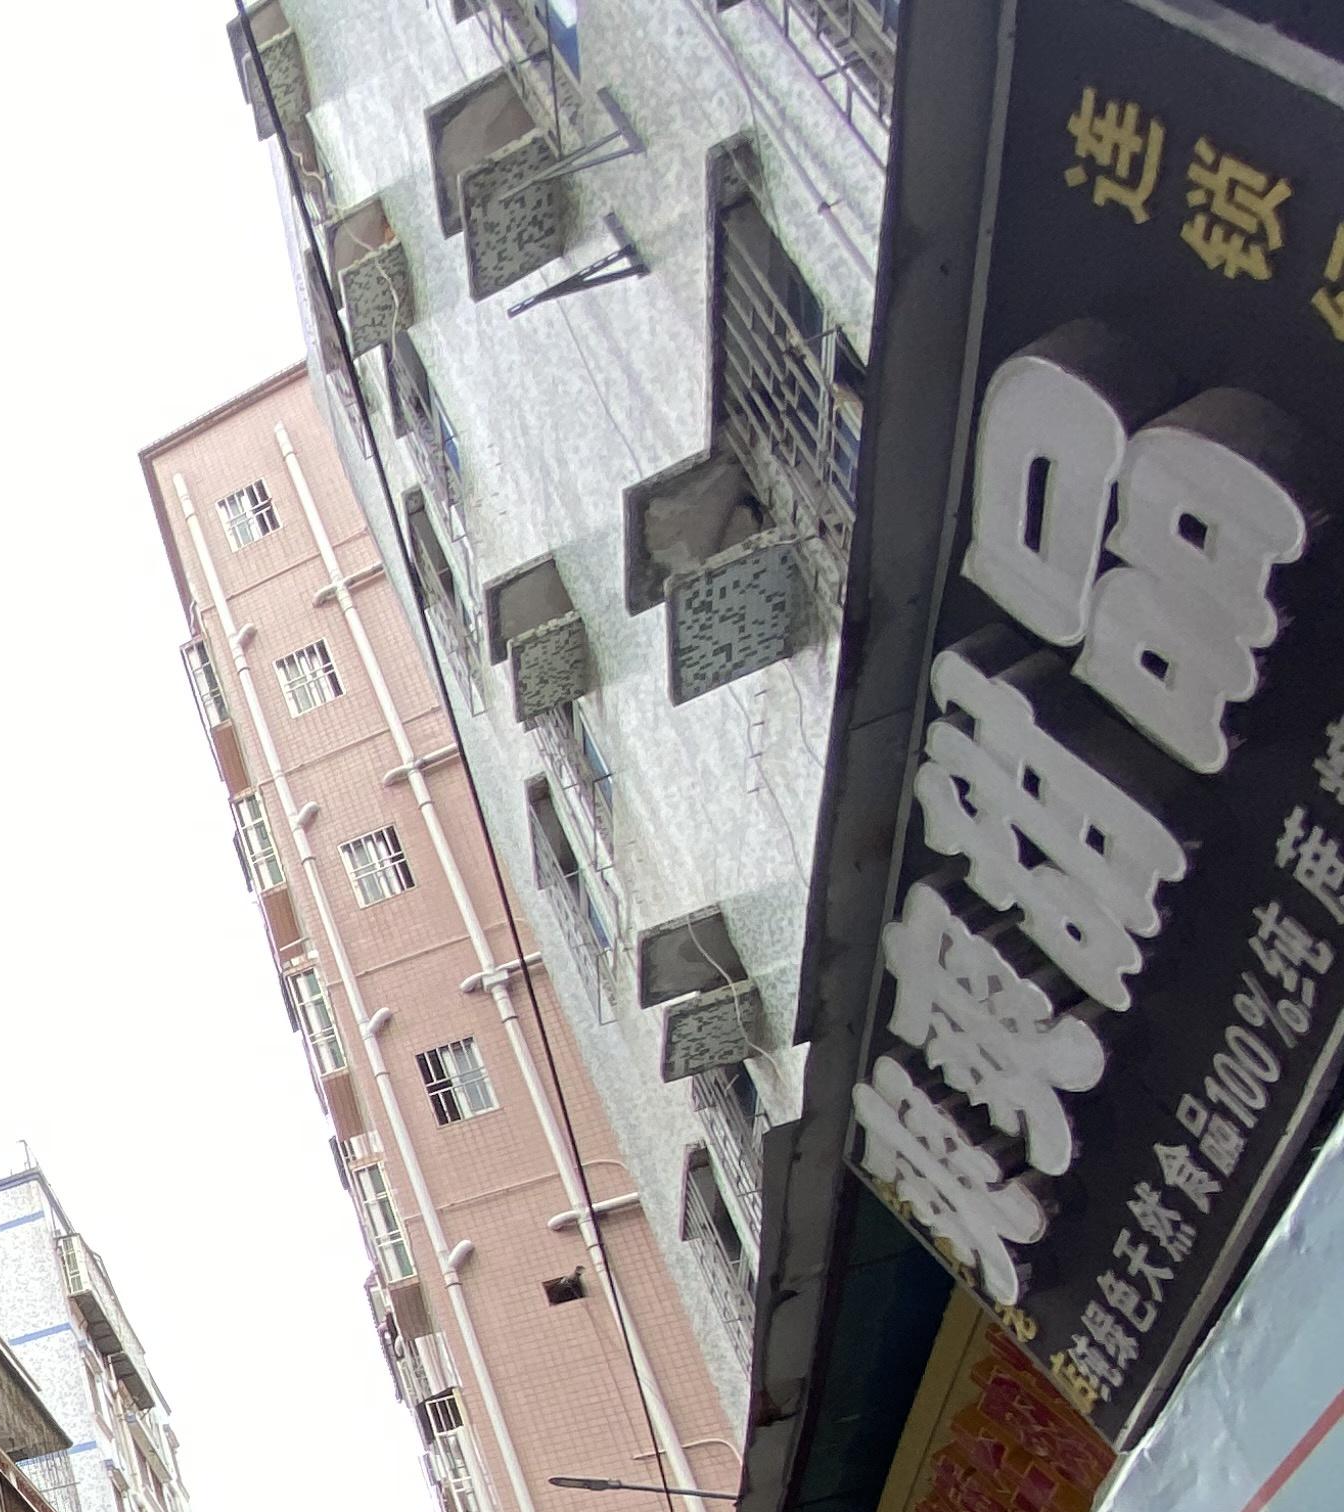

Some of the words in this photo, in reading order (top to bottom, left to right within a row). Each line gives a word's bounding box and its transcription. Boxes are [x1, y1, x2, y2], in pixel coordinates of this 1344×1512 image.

[1064, 85, 1344, 344] 连锁
[853, 352, 1307, 1306] 爽爽甜品
